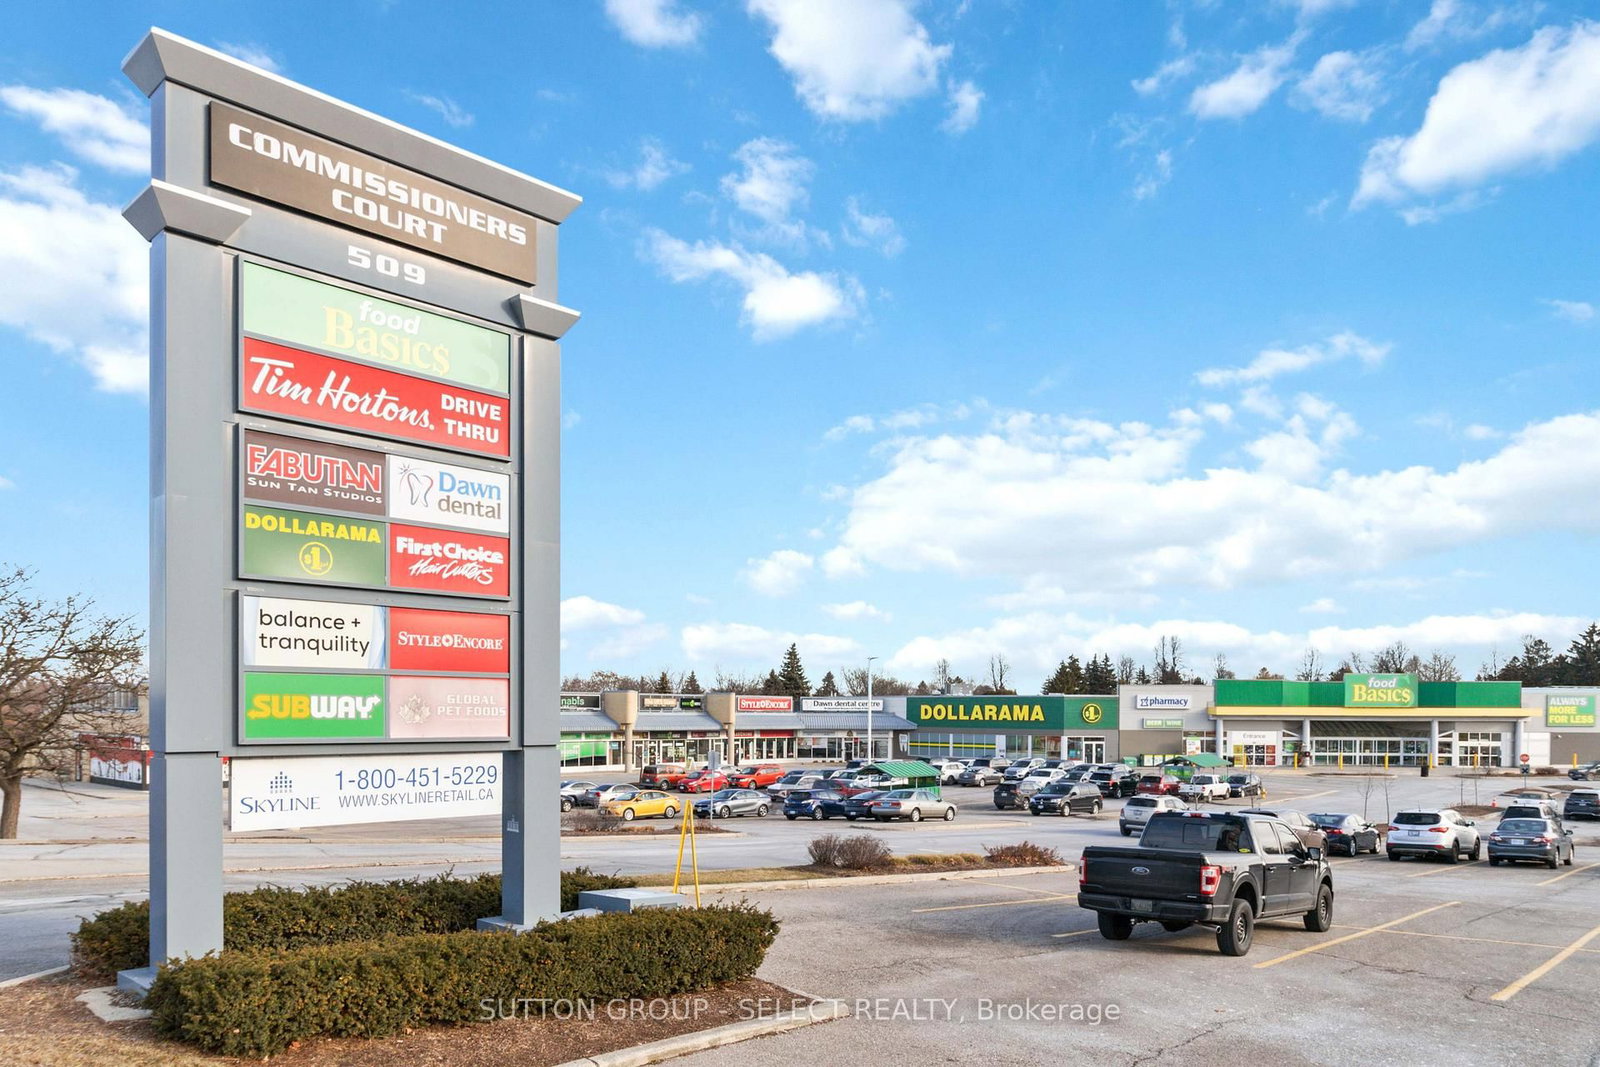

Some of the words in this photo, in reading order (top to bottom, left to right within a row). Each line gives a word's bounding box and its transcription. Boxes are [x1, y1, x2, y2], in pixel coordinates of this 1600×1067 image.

[228, 123, 527, 246] COMMISSIONERS
[331, 188, 448, 244] COURT
[347, 244, 427, 285] 509
[359, 301, 421, 335] food
[250, 355, 311, 406] Tim
[441, 393, 502, 422] DRIVE
[443, 418, 500, 443] THRU
[246, 443, 382, 494] FABUTAN
[247, 477, 281, 490] SUN
[287, 482, 318, 495] TAN
[323, 487, 383, 504] STUDIOS
[438, 471, 501, 501] Dawn
[438, 495, 501, 520] dental
[245, 512, 381, 543] DOLLARAMA
[396, 536, 442, 557] First
[443, 543, 504, 564] Choice
[409, 558, 442, 577] Hair
[440, 560, 494, 585] Cutters
[259, 608, 345, 630] balance
[258, 632, 370, 657] tranquility
[1368, 677, 1397, 688] food
[247, 694, 381, 720] SUBWAY
[437, 706, 461, 716] PET
[466, 707, 506, 718] FOODS
[447, 694, 497, 705] GLOBAL
[813, 700, 833, 708] Dawn
[834, 700, 857, 708] dental
[1149, 697, 1189, 707] pharmacy
[1549, 706, 1577, 714] MORE
[1550, 697, 1587, 706] ALWAYS
[920, 704, 1045, 721] DOLLARAMA
[1549, 715, 1568, 724] FOR
[1570, 715, 1594, 724] LESS
[335, 765, 498, 791] 1-800-451-5229
[239, 796, 321, 815] SKYLINE
[338, 788, 494, 809] WWW.SKYLINERETAIL.CA
